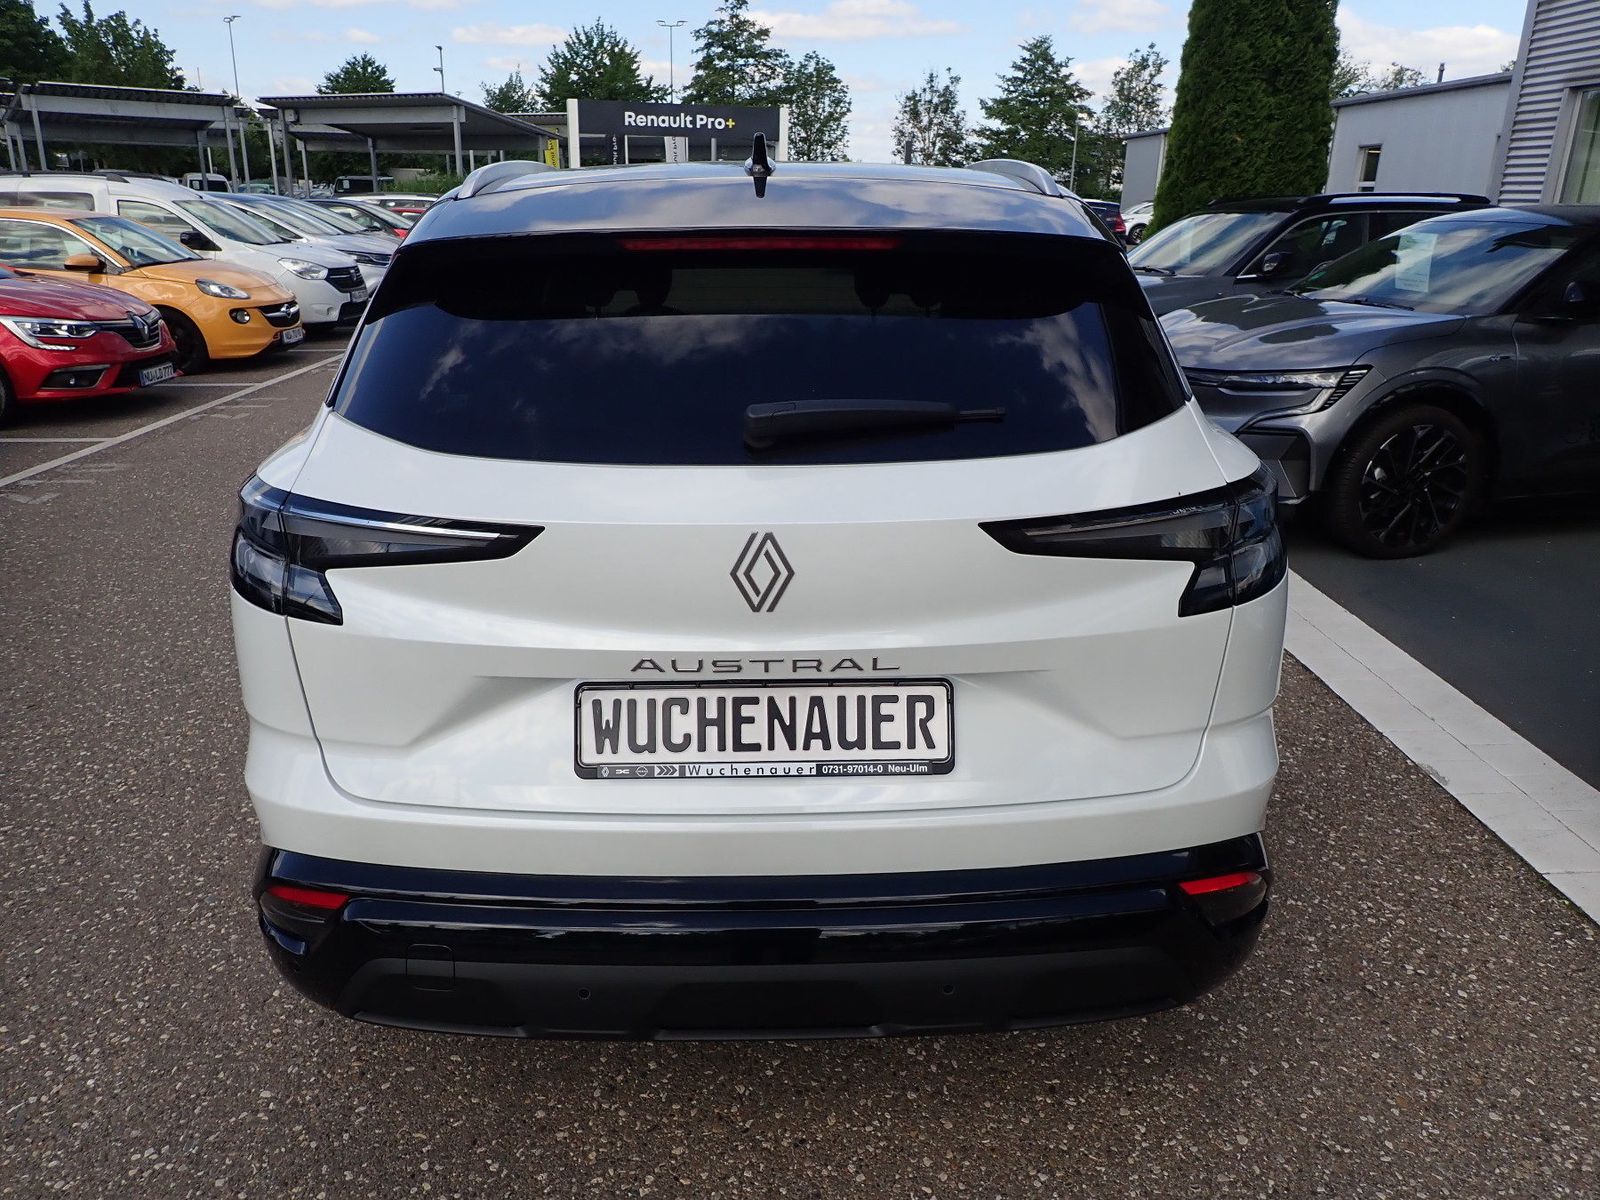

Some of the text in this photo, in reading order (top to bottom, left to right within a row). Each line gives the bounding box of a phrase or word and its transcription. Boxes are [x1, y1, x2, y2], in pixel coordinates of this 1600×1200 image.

[624, 111, 736, 130] Renault Pro+
[630, 656, 900, 674] AUSTRAL
[592, 694, 936, 755] WUCHENAUER
[688, 764, 928, 777] Wuchenauer 0731-97014-0 Neu-Ulm
